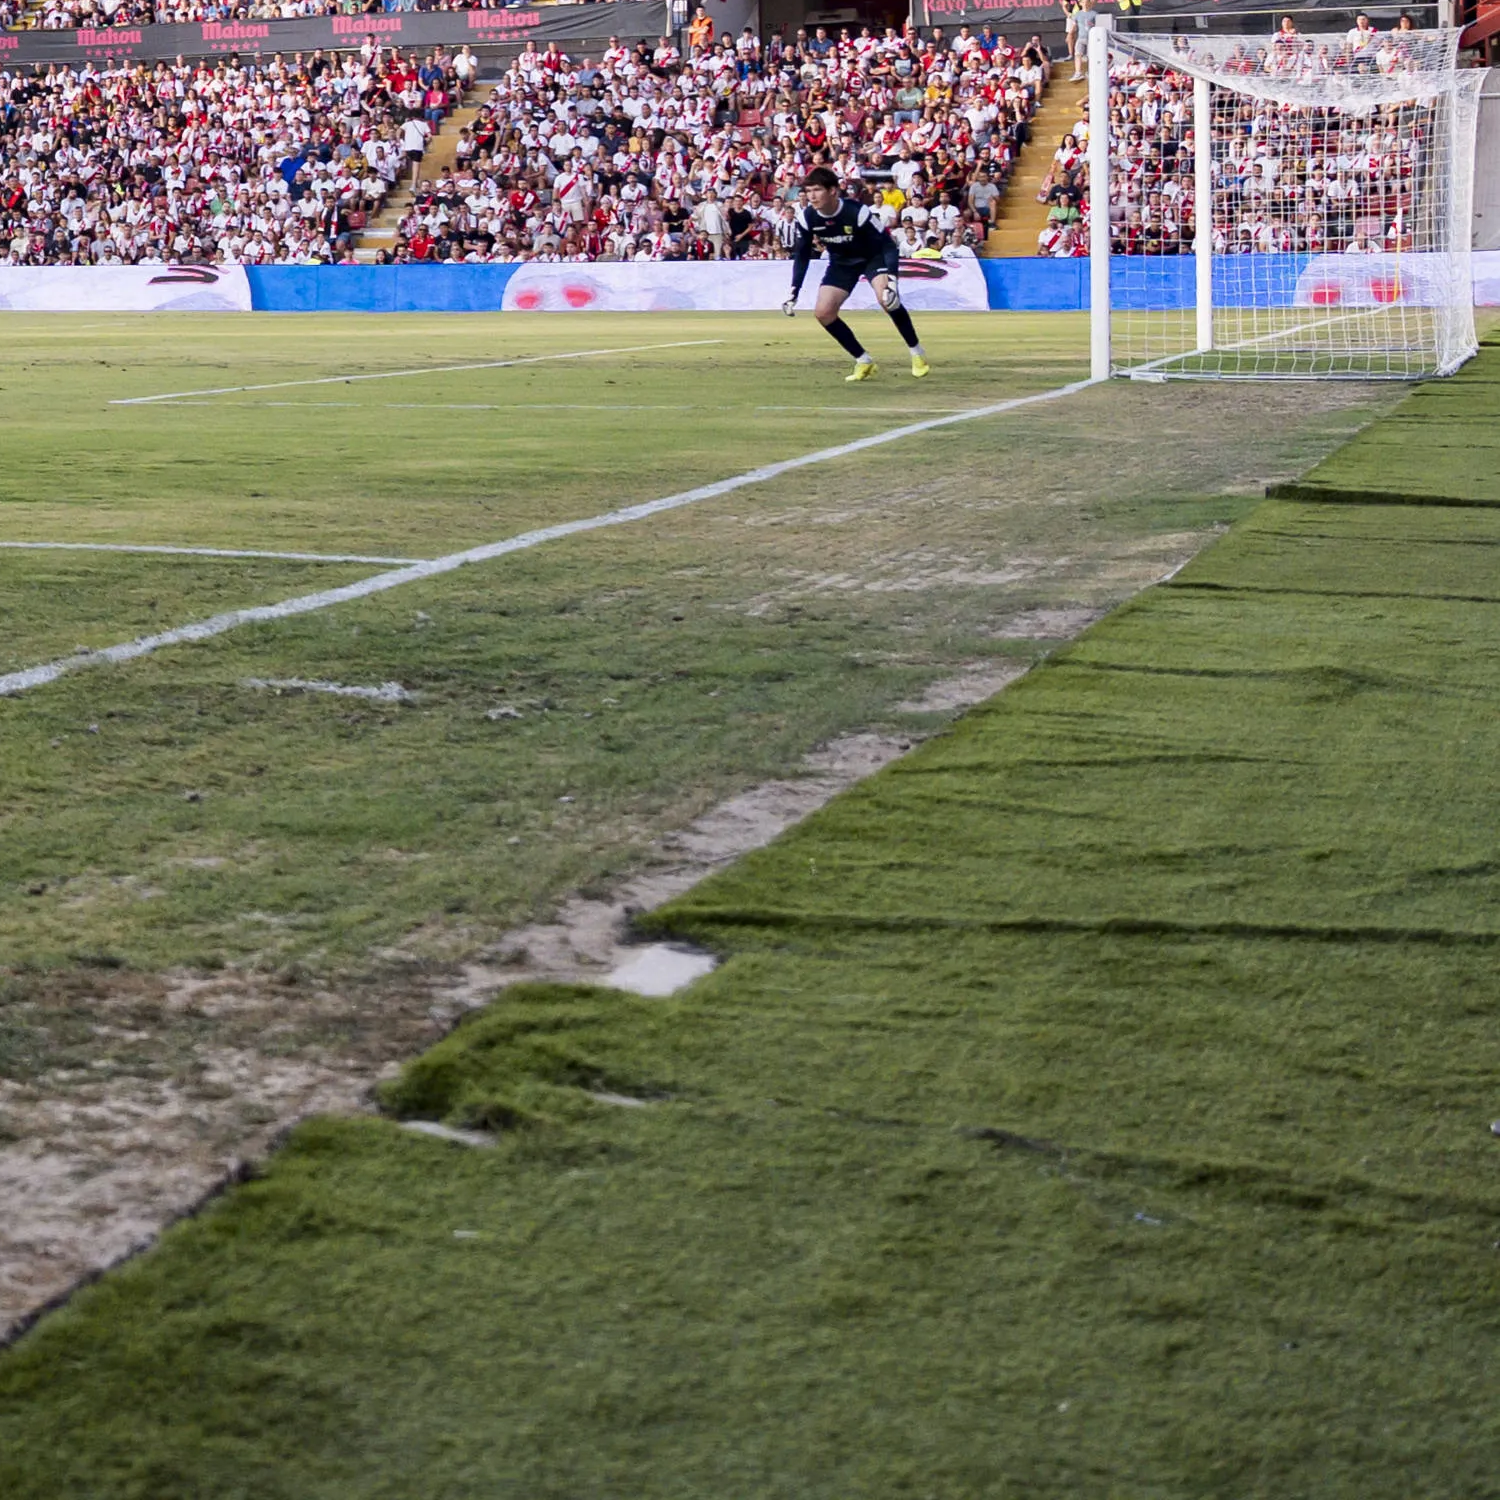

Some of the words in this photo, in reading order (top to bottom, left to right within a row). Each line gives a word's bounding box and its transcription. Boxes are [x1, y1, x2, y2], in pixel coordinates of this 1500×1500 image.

[332, 13, 402, 34] Mahou
[467, 9, 540, 29] Mahou
[77, 27, 142, 46] Mahou
[202, 21, 269, 40] Mahou
